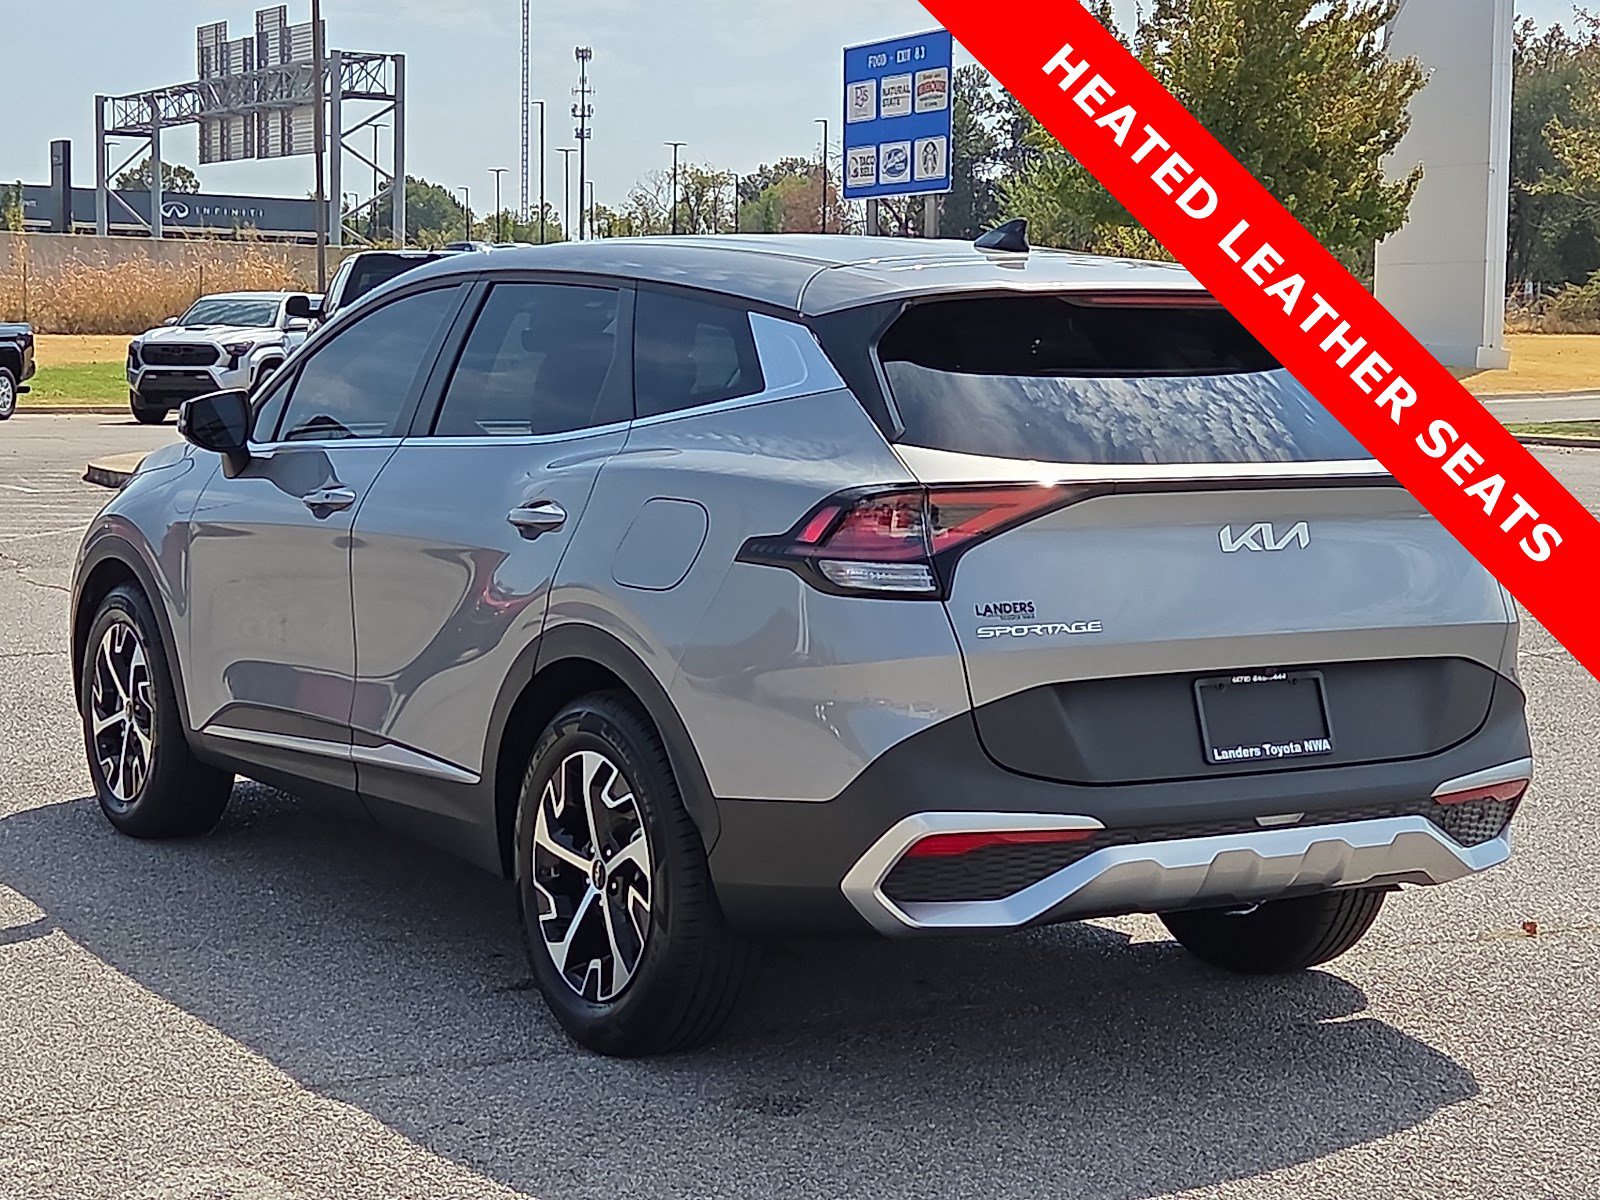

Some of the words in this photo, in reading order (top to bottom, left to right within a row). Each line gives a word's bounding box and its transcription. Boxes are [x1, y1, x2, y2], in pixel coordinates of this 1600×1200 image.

[868, 54, 887, 69] FOOD
[896, 48, 911, 63] EXIT
[914, 45, 925, 60] 83
[882, 85, 910, 97] NATURAL
[882, 98, 901, 107] STATE
[859, 155, 875, 166] TACO
[860, 166, 874, 177] BELL
[195, 206, 263, 218] INFINITI
[1219, 522, 1310, 552] KIA
[975, 602, 1035, 616] LANDERS
[977, 620, 1102, 638] SPORTAGE
[1214, 746, 1261, 760] Landers
[1262, 742, 1302, 758] Toyota
[1303, 738, 1331, 753] NWA
